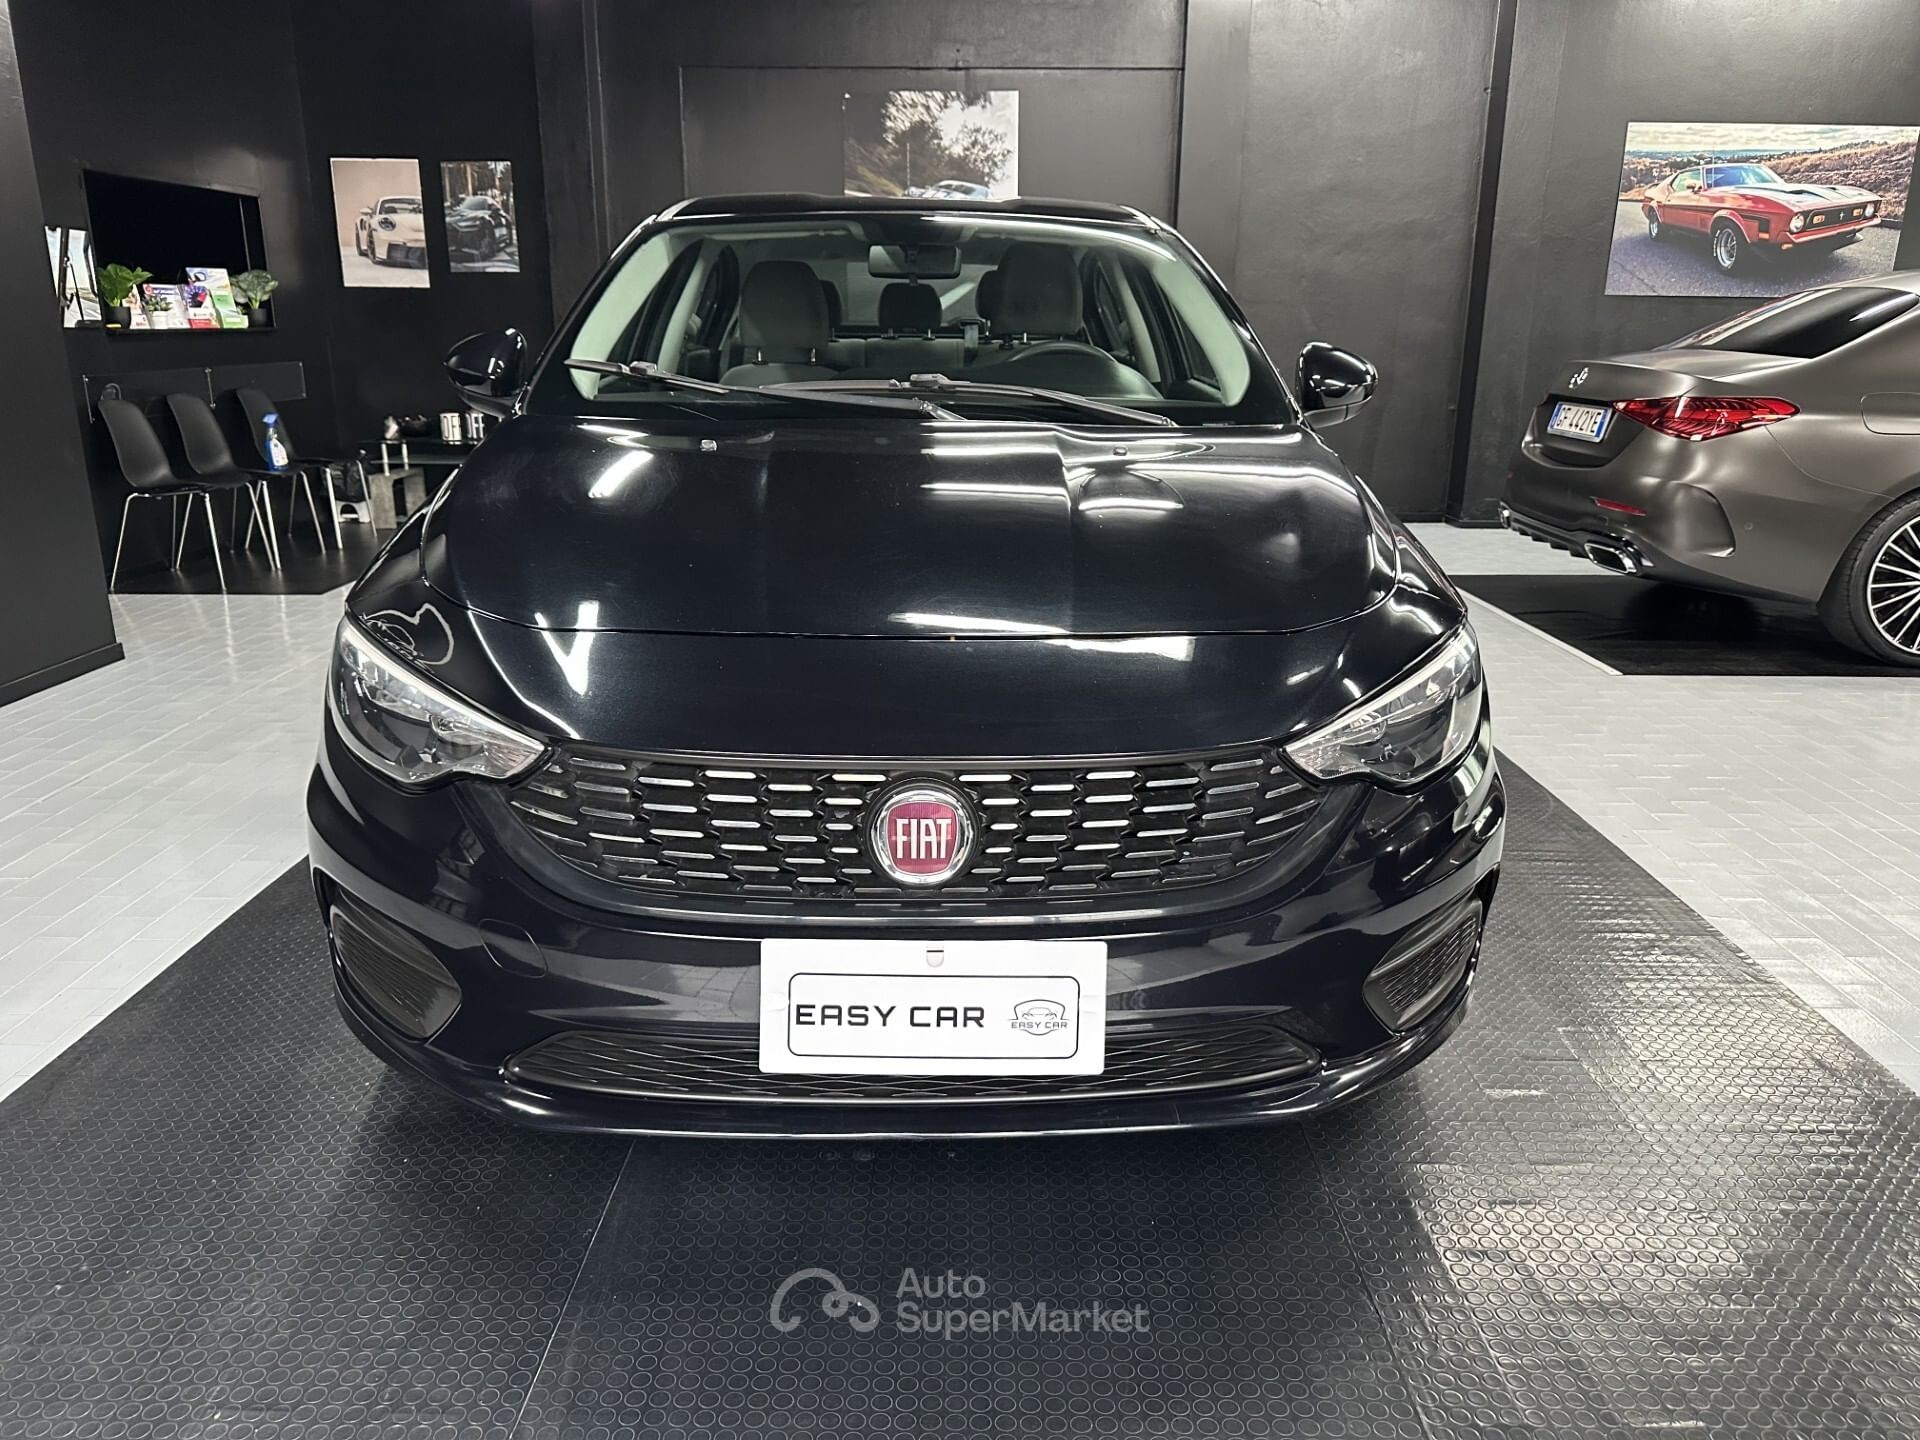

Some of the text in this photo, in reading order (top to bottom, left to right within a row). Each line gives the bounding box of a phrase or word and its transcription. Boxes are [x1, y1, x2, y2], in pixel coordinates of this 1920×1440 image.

[896, 818, 952, 859] FIAT
[795, 1004, 985, 1028] EASY CAR
[1011, 1021, 1068, 1029] EASY CAR
